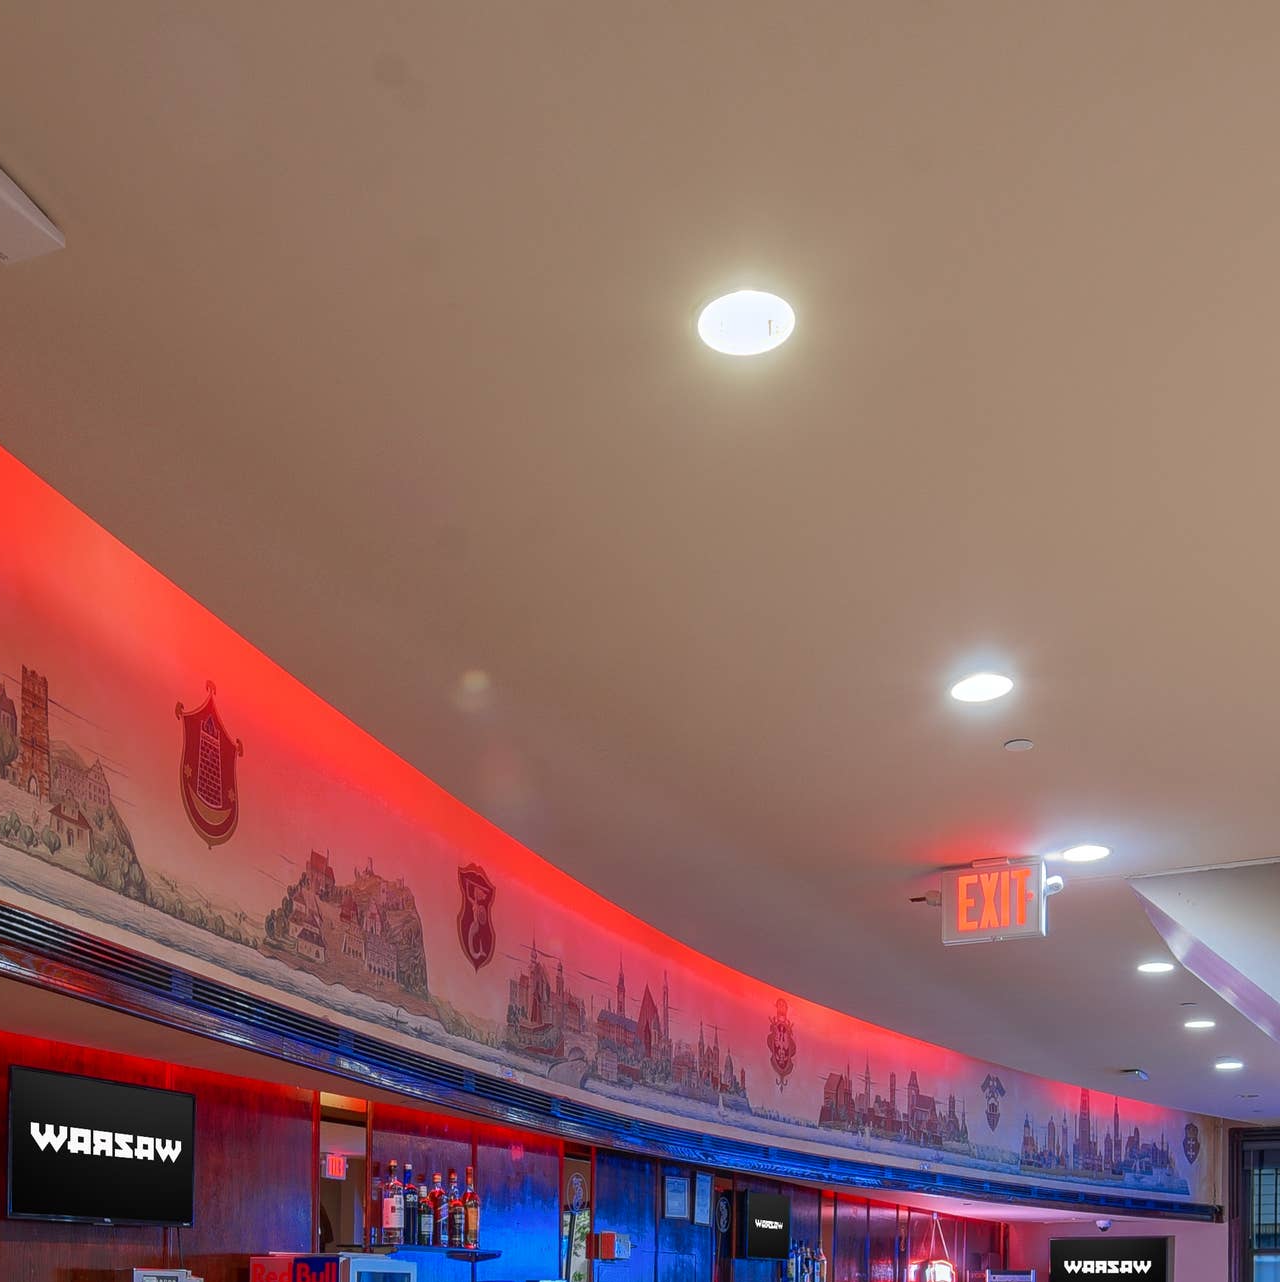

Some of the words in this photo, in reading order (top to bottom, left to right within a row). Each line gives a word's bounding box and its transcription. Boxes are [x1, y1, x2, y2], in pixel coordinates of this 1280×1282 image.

[958, 868, 1032, 932] EXIT
[30, 1121, 182, 1164] WARSAW
[1063, 1260, 1152, 1274] WARSAW
